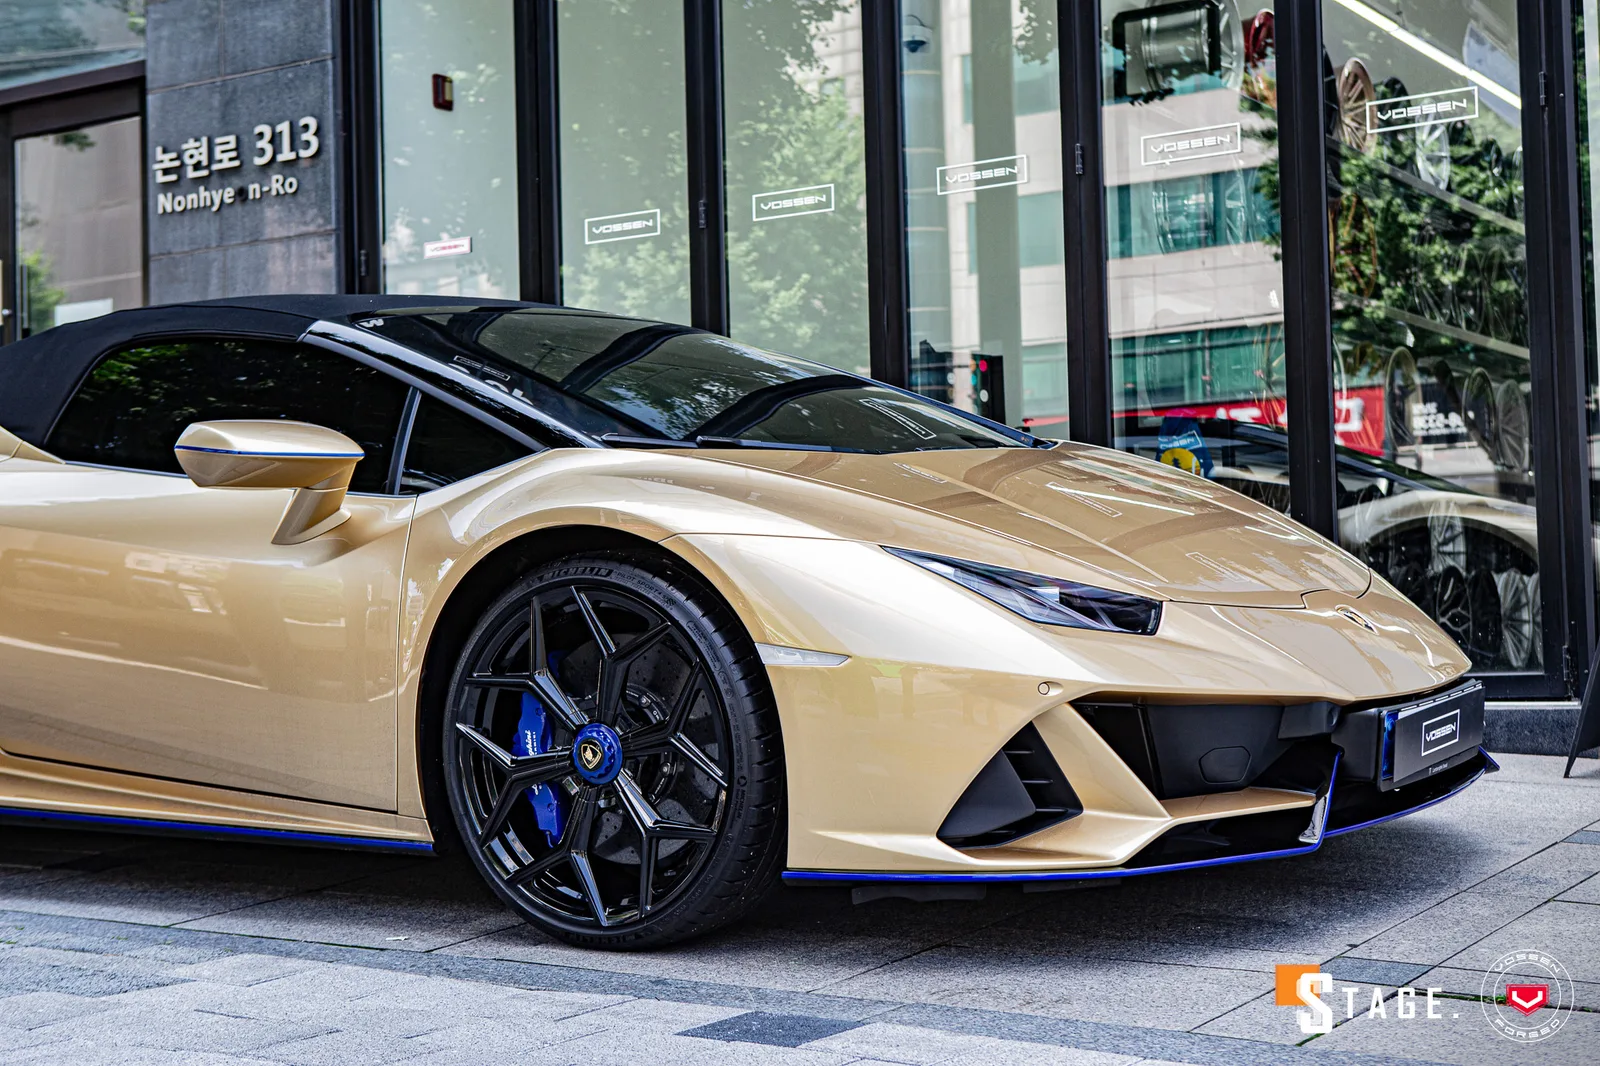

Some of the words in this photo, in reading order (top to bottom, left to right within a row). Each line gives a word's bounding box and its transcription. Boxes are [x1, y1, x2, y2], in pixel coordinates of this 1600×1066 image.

[1377, 99, 1467, 120] VOSSEN
[152, 134, 241, 184] 논현로
[253, 116, 319, 166] 313
[1151, 134, 1231, 153] VOSSEN
[945, 165, 1018, 183] VOSSEN
[157, 174, 298, 215] Nonhyen-Ro
[760, 194, 826, 210] VOSSEN
[592, 219, 653, 234] VOSSEN
[543, 567, 608, 580] MICHELIN
[1426, 722, 1456, 742] VOSSEN
